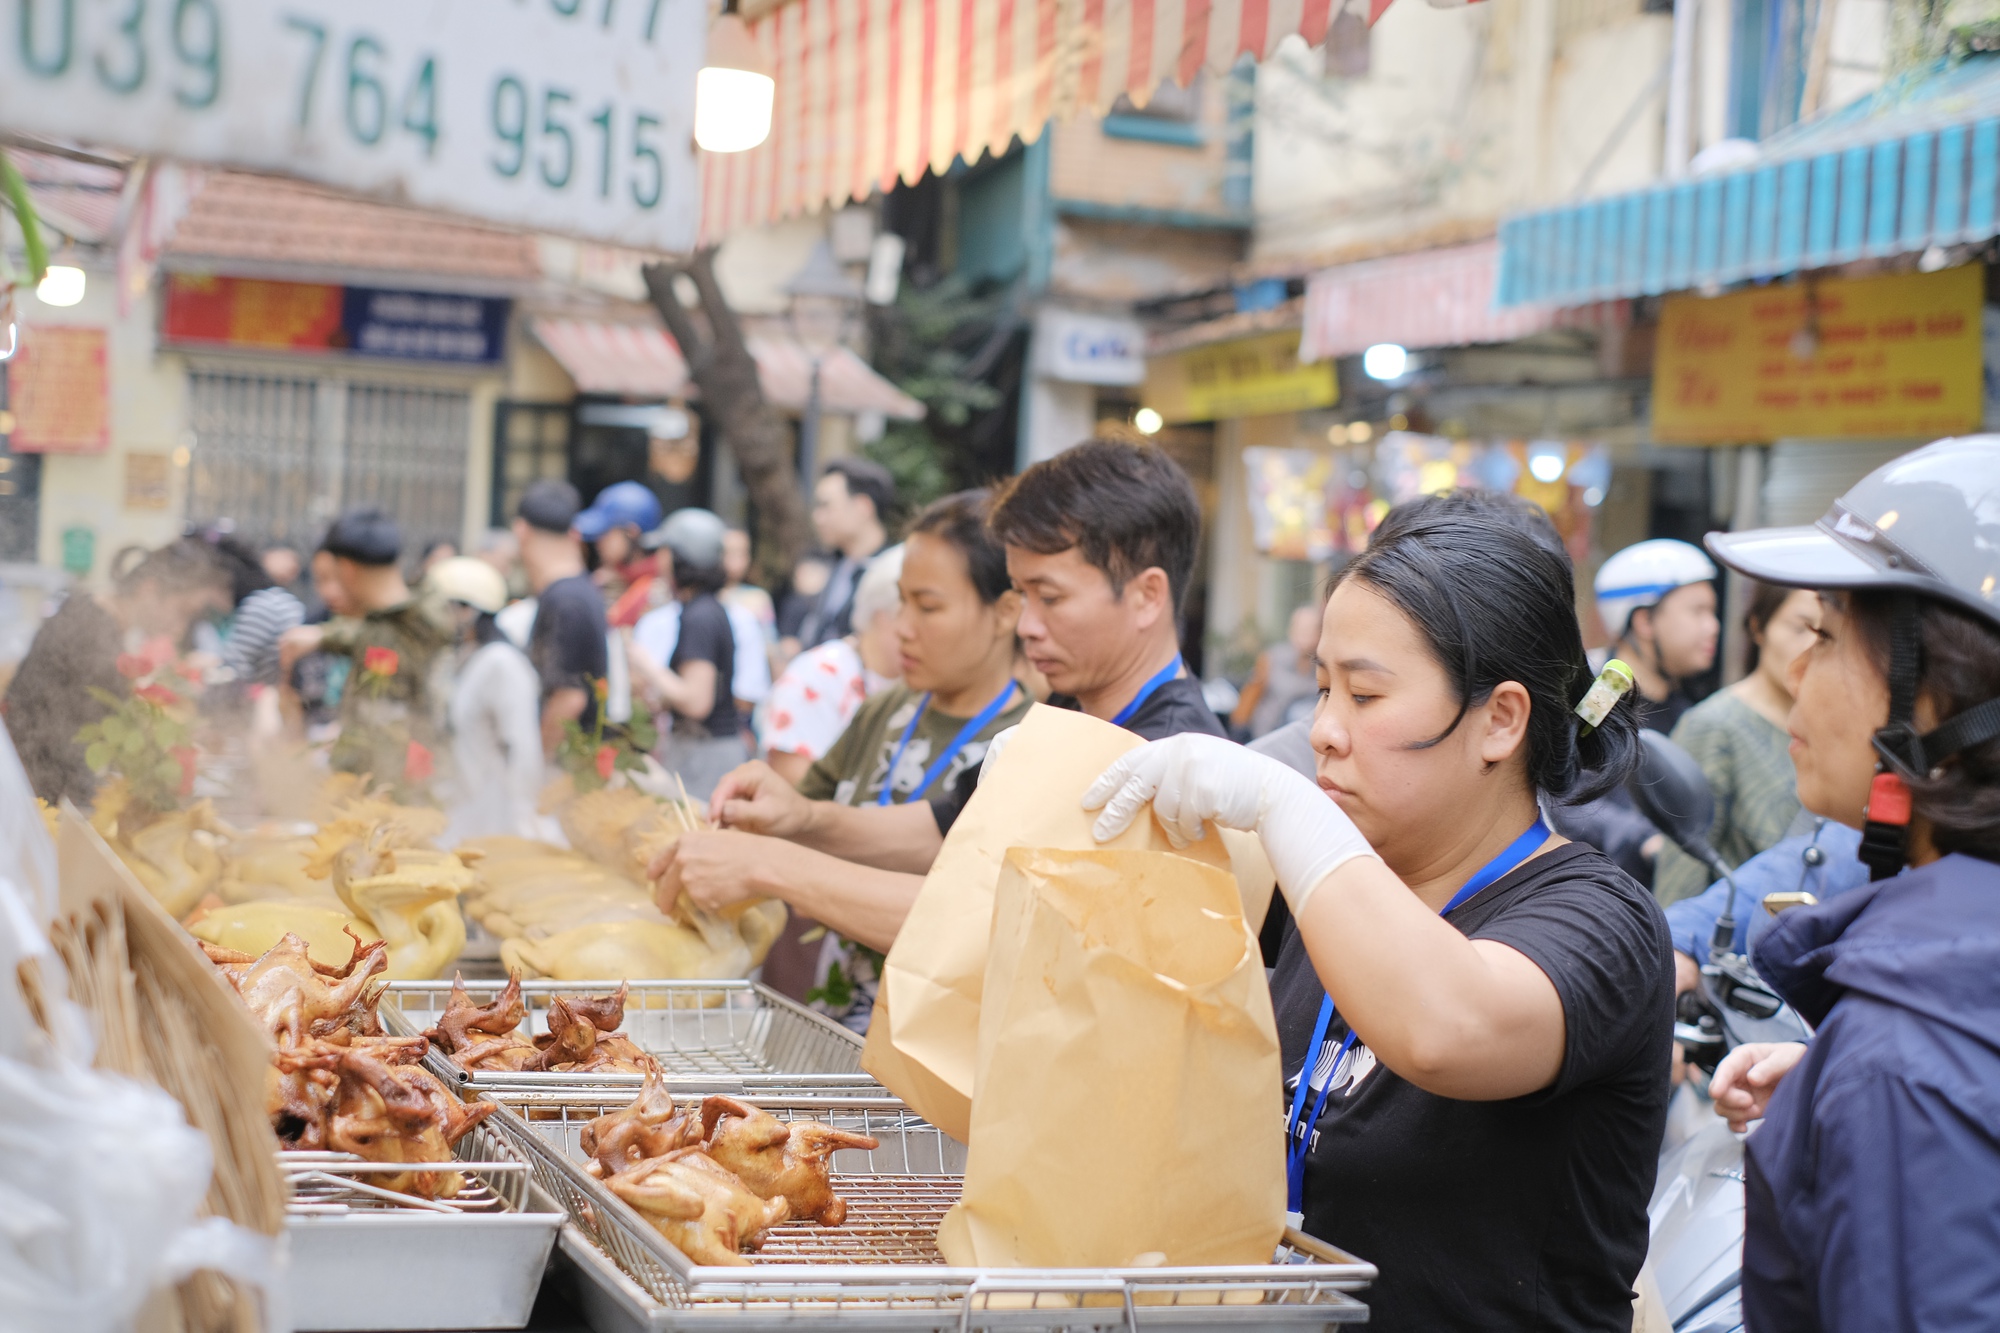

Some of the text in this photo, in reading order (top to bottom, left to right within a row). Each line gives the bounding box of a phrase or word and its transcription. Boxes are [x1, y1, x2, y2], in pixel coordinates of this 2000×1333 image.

[17, 0, 666, 210] 039 764 9515
